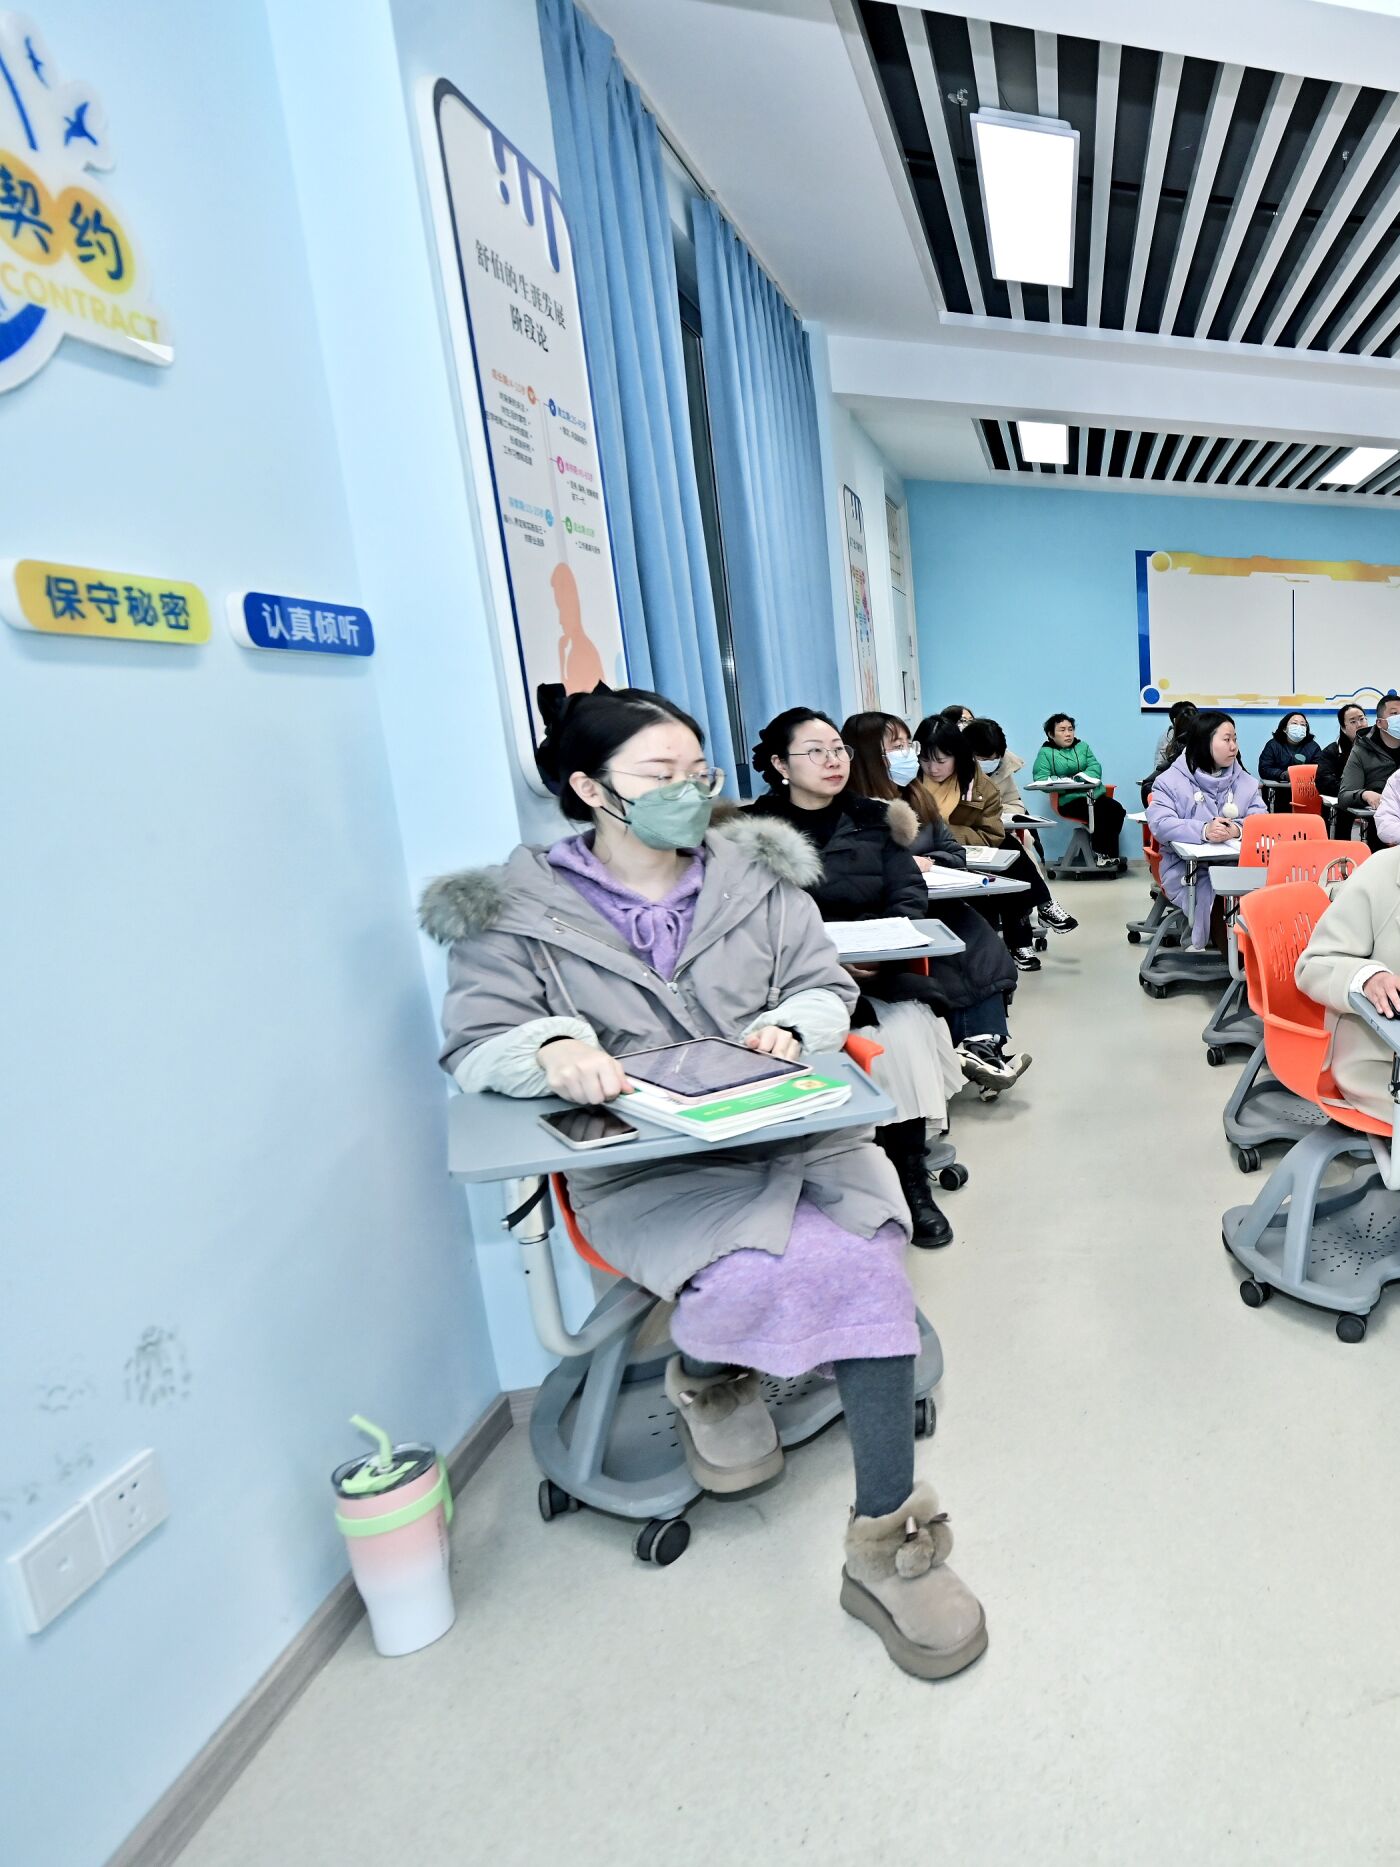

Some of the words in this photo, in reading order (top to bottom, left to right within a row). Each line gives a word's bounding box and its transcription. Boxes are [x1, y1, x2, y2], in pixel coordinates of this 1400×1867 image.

[0, 164, 123, 280] 契约
[1, 262, 158, 341] CONTRACT
[475, 239, 566, 330] 舒伯的生涯发展
[510, 304, 549, 352] 阶段论
[44, 574, 191, 631] 保守秘密
[261, 602, 360, 648] 认真倾听
